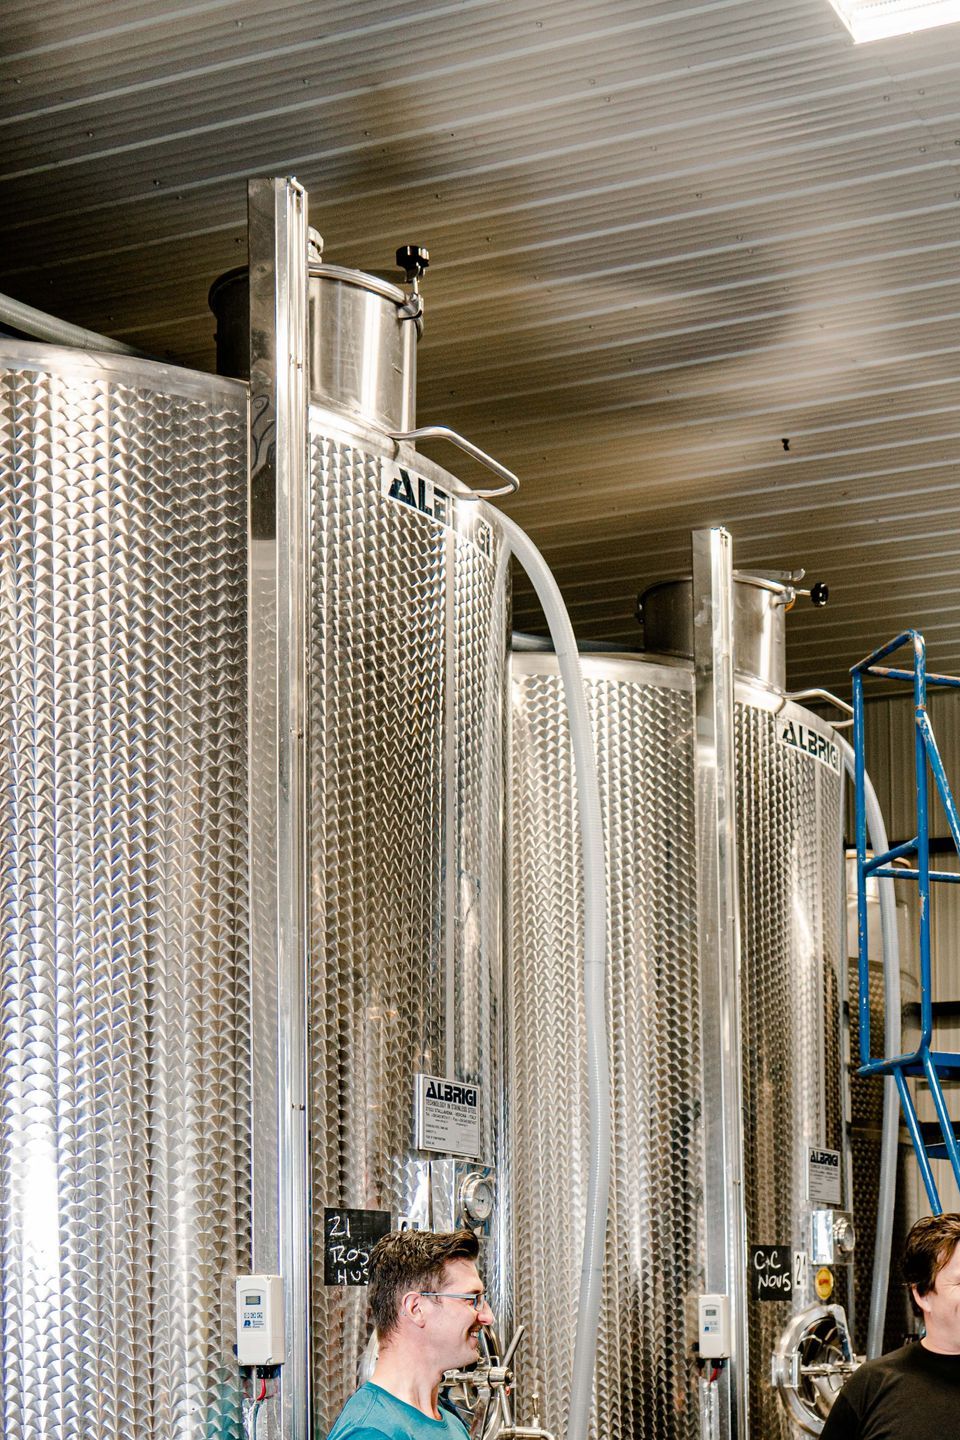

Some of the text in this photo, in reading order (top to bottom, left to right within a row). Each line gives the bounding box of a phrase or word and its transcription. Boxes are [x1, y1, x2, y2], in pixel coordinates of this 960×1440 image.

[388, 467, 492, 558] ALBGI
[426, 1081, 477, 1107] ALBRIGI
[328, 1216, 351, 1238] 21
